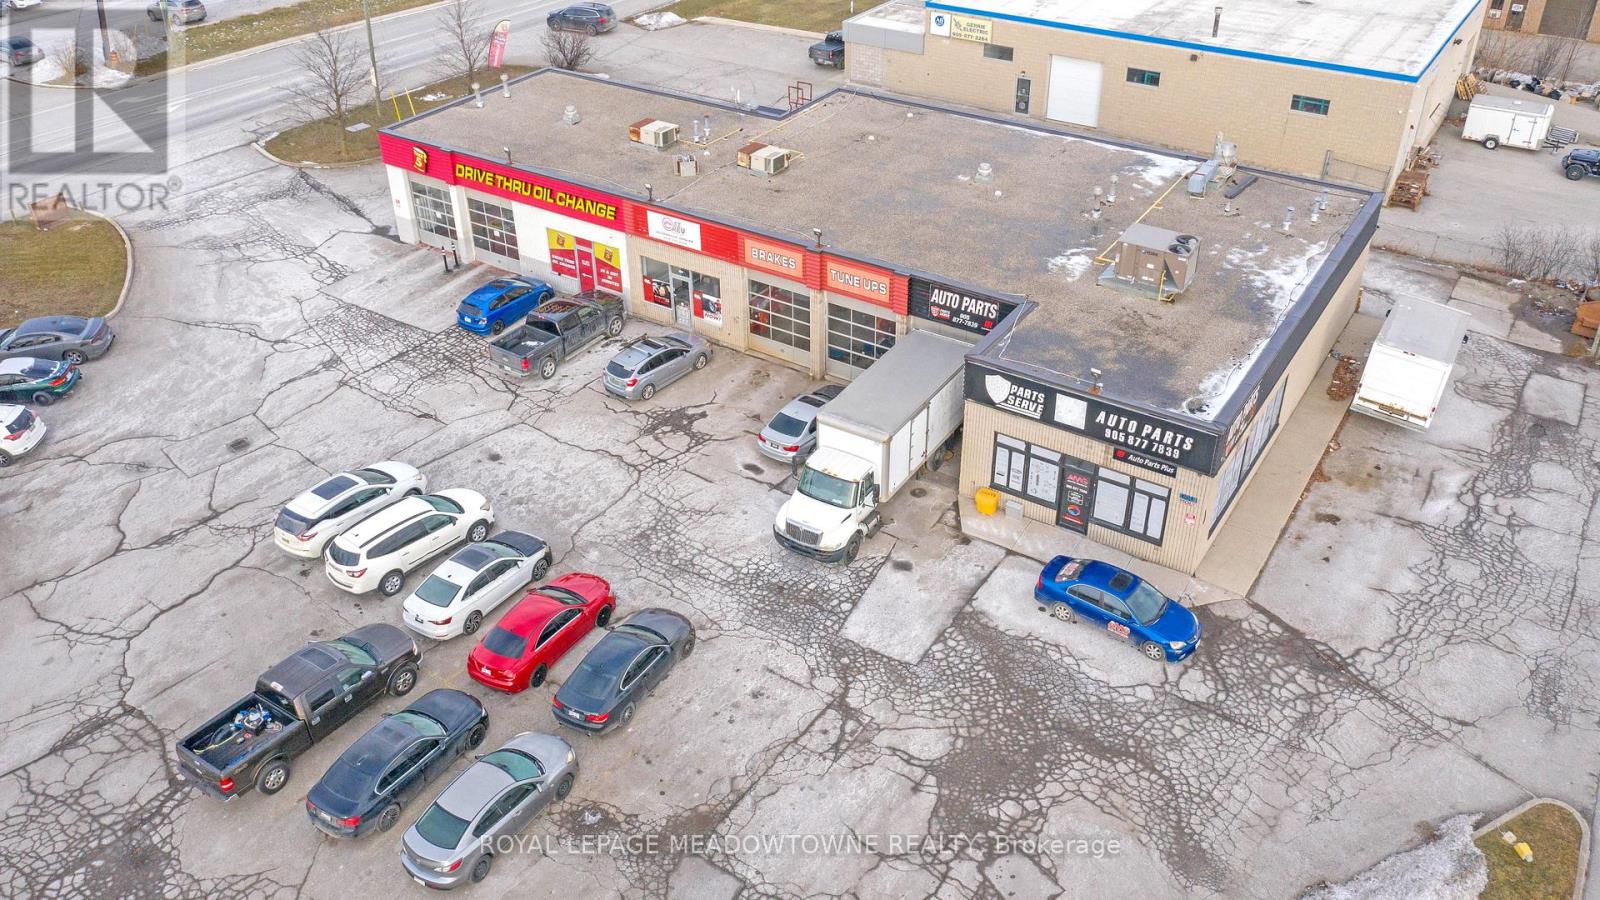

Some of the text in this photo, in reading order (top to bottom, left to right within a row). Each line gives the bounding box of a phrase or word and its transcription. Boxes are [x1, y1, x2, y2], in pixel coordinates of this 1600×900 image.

[455, 163, 616, 220] DRIVE THRU OIL CHANGE
[751, 248, 796, 269] BRAKES
[830, 269, 887, 295] TUNE UPS
[930, 288, 960, 309] AUTO
[961, 296, 998, 319] PARTS
[1007, 395, 1044, 415] SERVE
[1010, 384, 1045, 403] PARTS
[1095, 410, 1194, 451] AUTO PARTS
[1104, 428, 1180, 459] 905 877 7839
[1127, 454, 1175, 474] Auto Parts Plus
